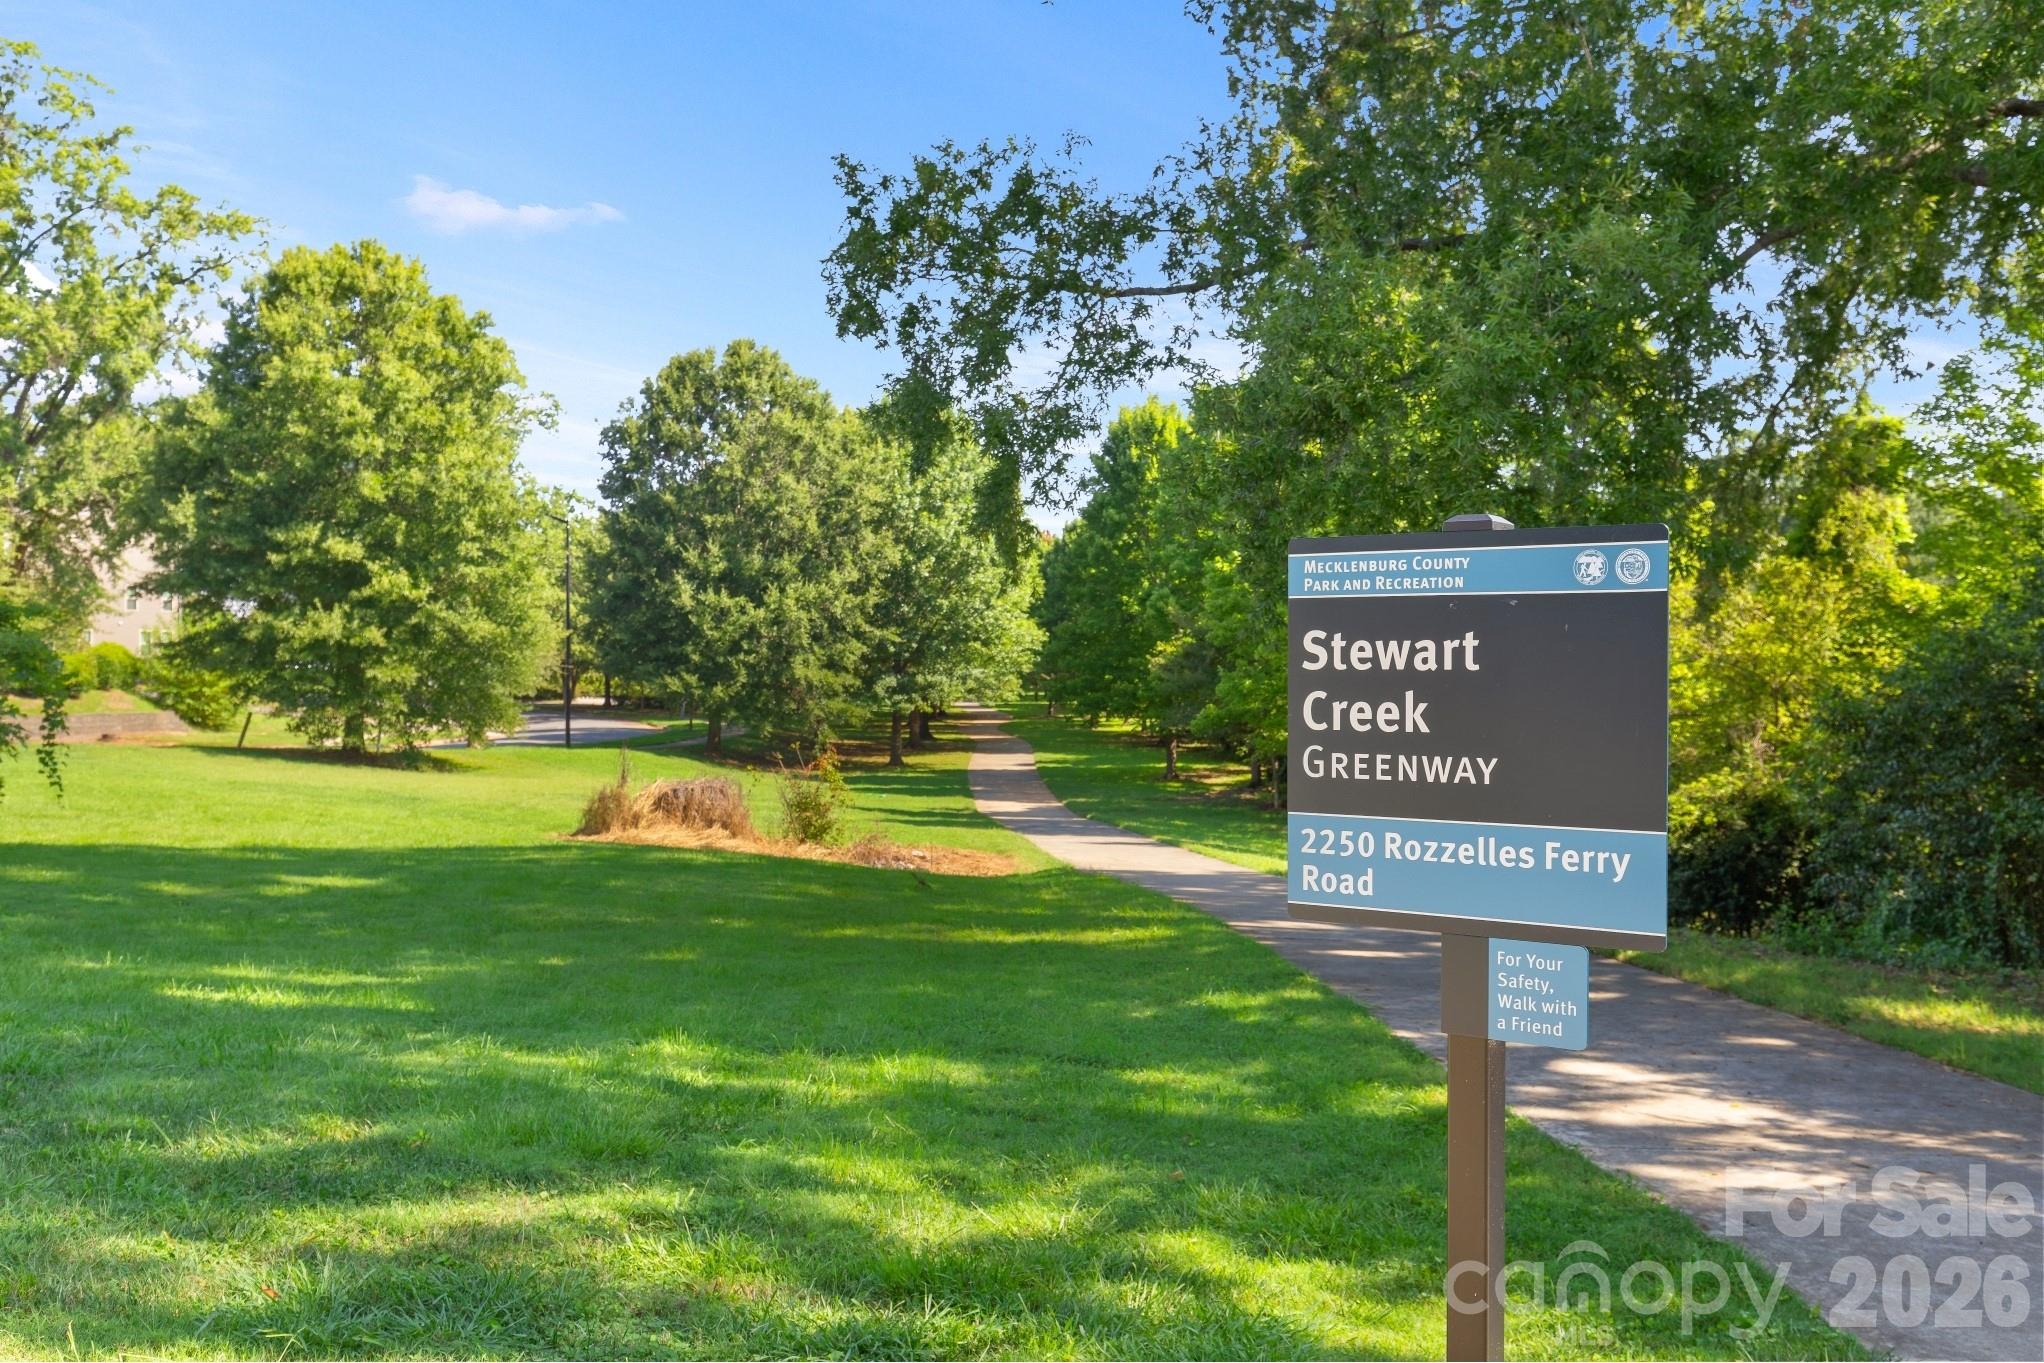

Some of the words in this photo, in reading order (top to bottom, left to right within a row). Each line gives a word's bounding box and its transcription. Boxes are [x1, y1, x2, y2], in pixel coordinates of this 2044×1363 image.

[1412, 556, 1470, 571] COUNTY
[1304, 578, 1339, 592] PARK
[1343, 579, 1371, 591] AND
[1375, 576, 1464, 590] RECREATION
[1302, 629, 1480, 671] Stewart
[1302, 690, 1430, 733] Creek
[1302, 744, 1498, 785] GREENWAY
[1300, 828, 1375, 858] 2250
[1384, 832, 1535, 869] Rozzelles
[1544, 841, 1632, 883] Ferry
[1302, 864, 1374, 896] Road
[1497, 951, 1522, 967] For
[1526, 953, 1564, 971] Your
[1498, 972, 1554, 995] Safety,
[1498, 993, 1537, 1012] Walk
[1541, 999, 1577, 1016] with
[1497, 1018, 1505, 1029] a
[1512, 1016, 1562, 1037] Friend
